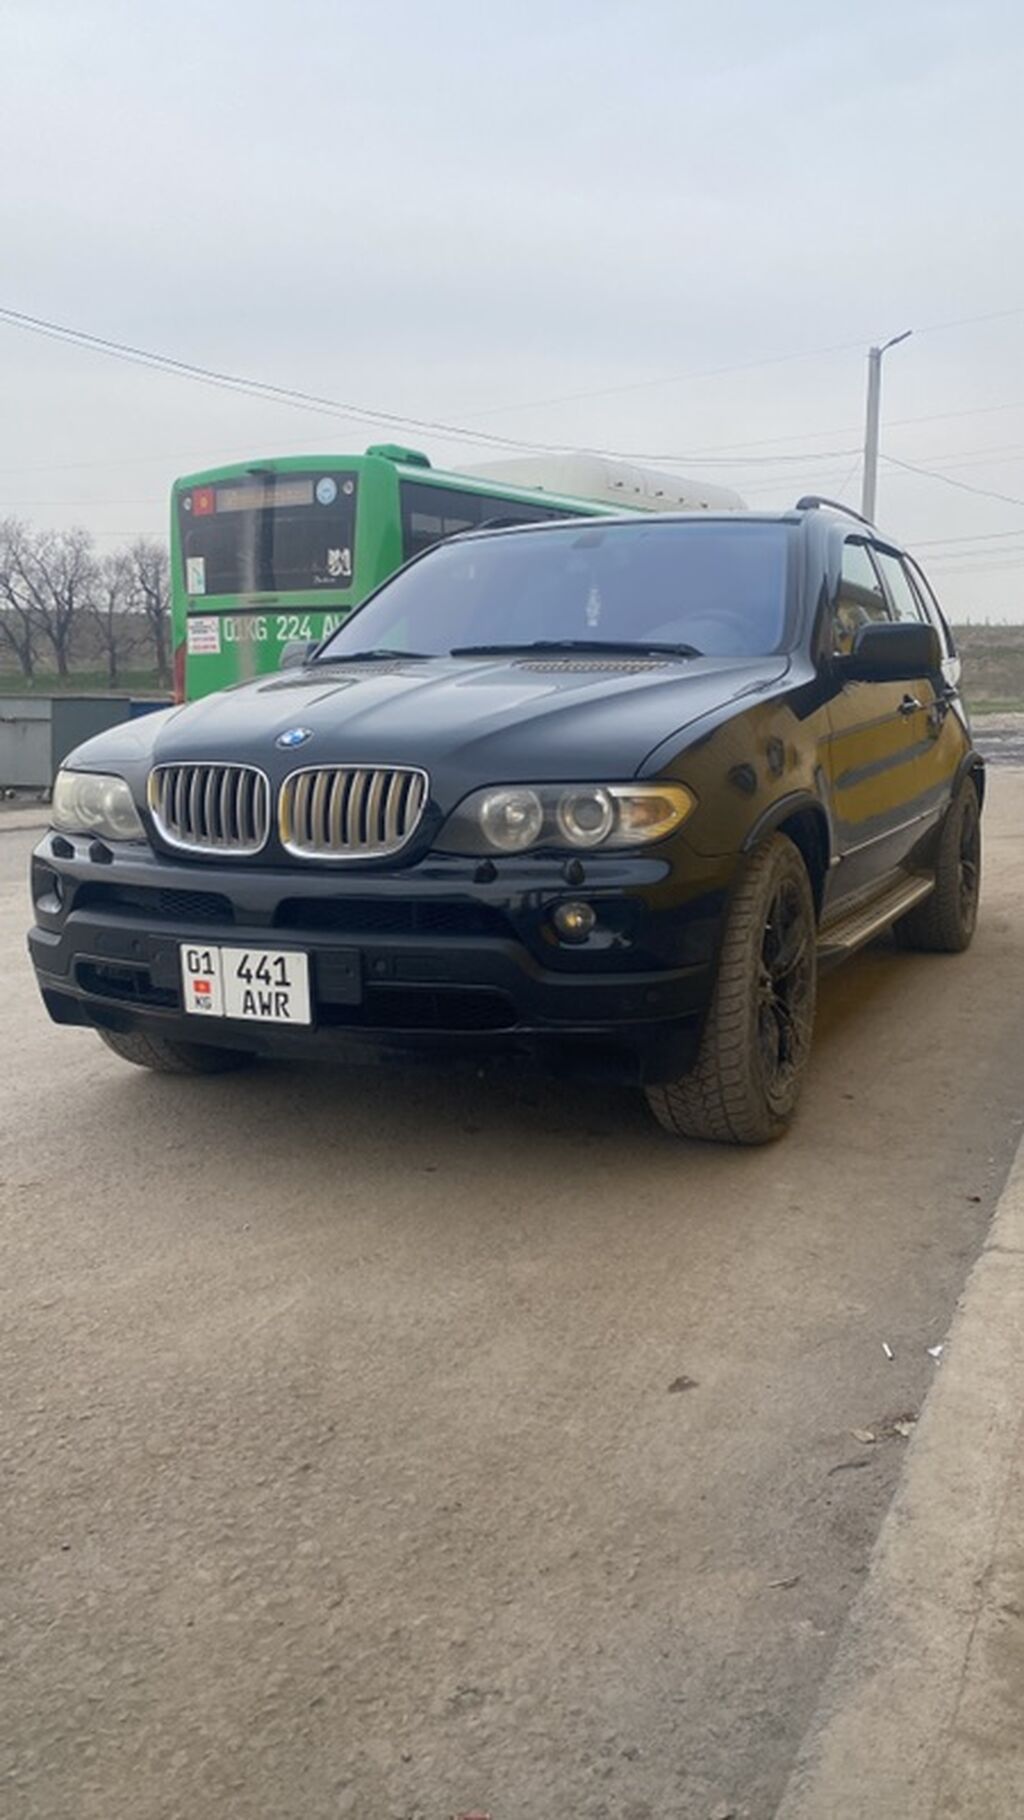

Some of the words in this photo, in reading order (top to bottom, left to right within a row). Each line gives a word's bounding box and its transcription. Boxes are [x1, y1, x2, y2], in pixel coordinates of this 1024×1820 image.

[276, 615, 312, 641] 224
[187, 950, 215, 975] 01
[237, 954, 291, 987] 441
[195, 997, 212, 1010] KG
[243, 990, 290, 1018] AWR
